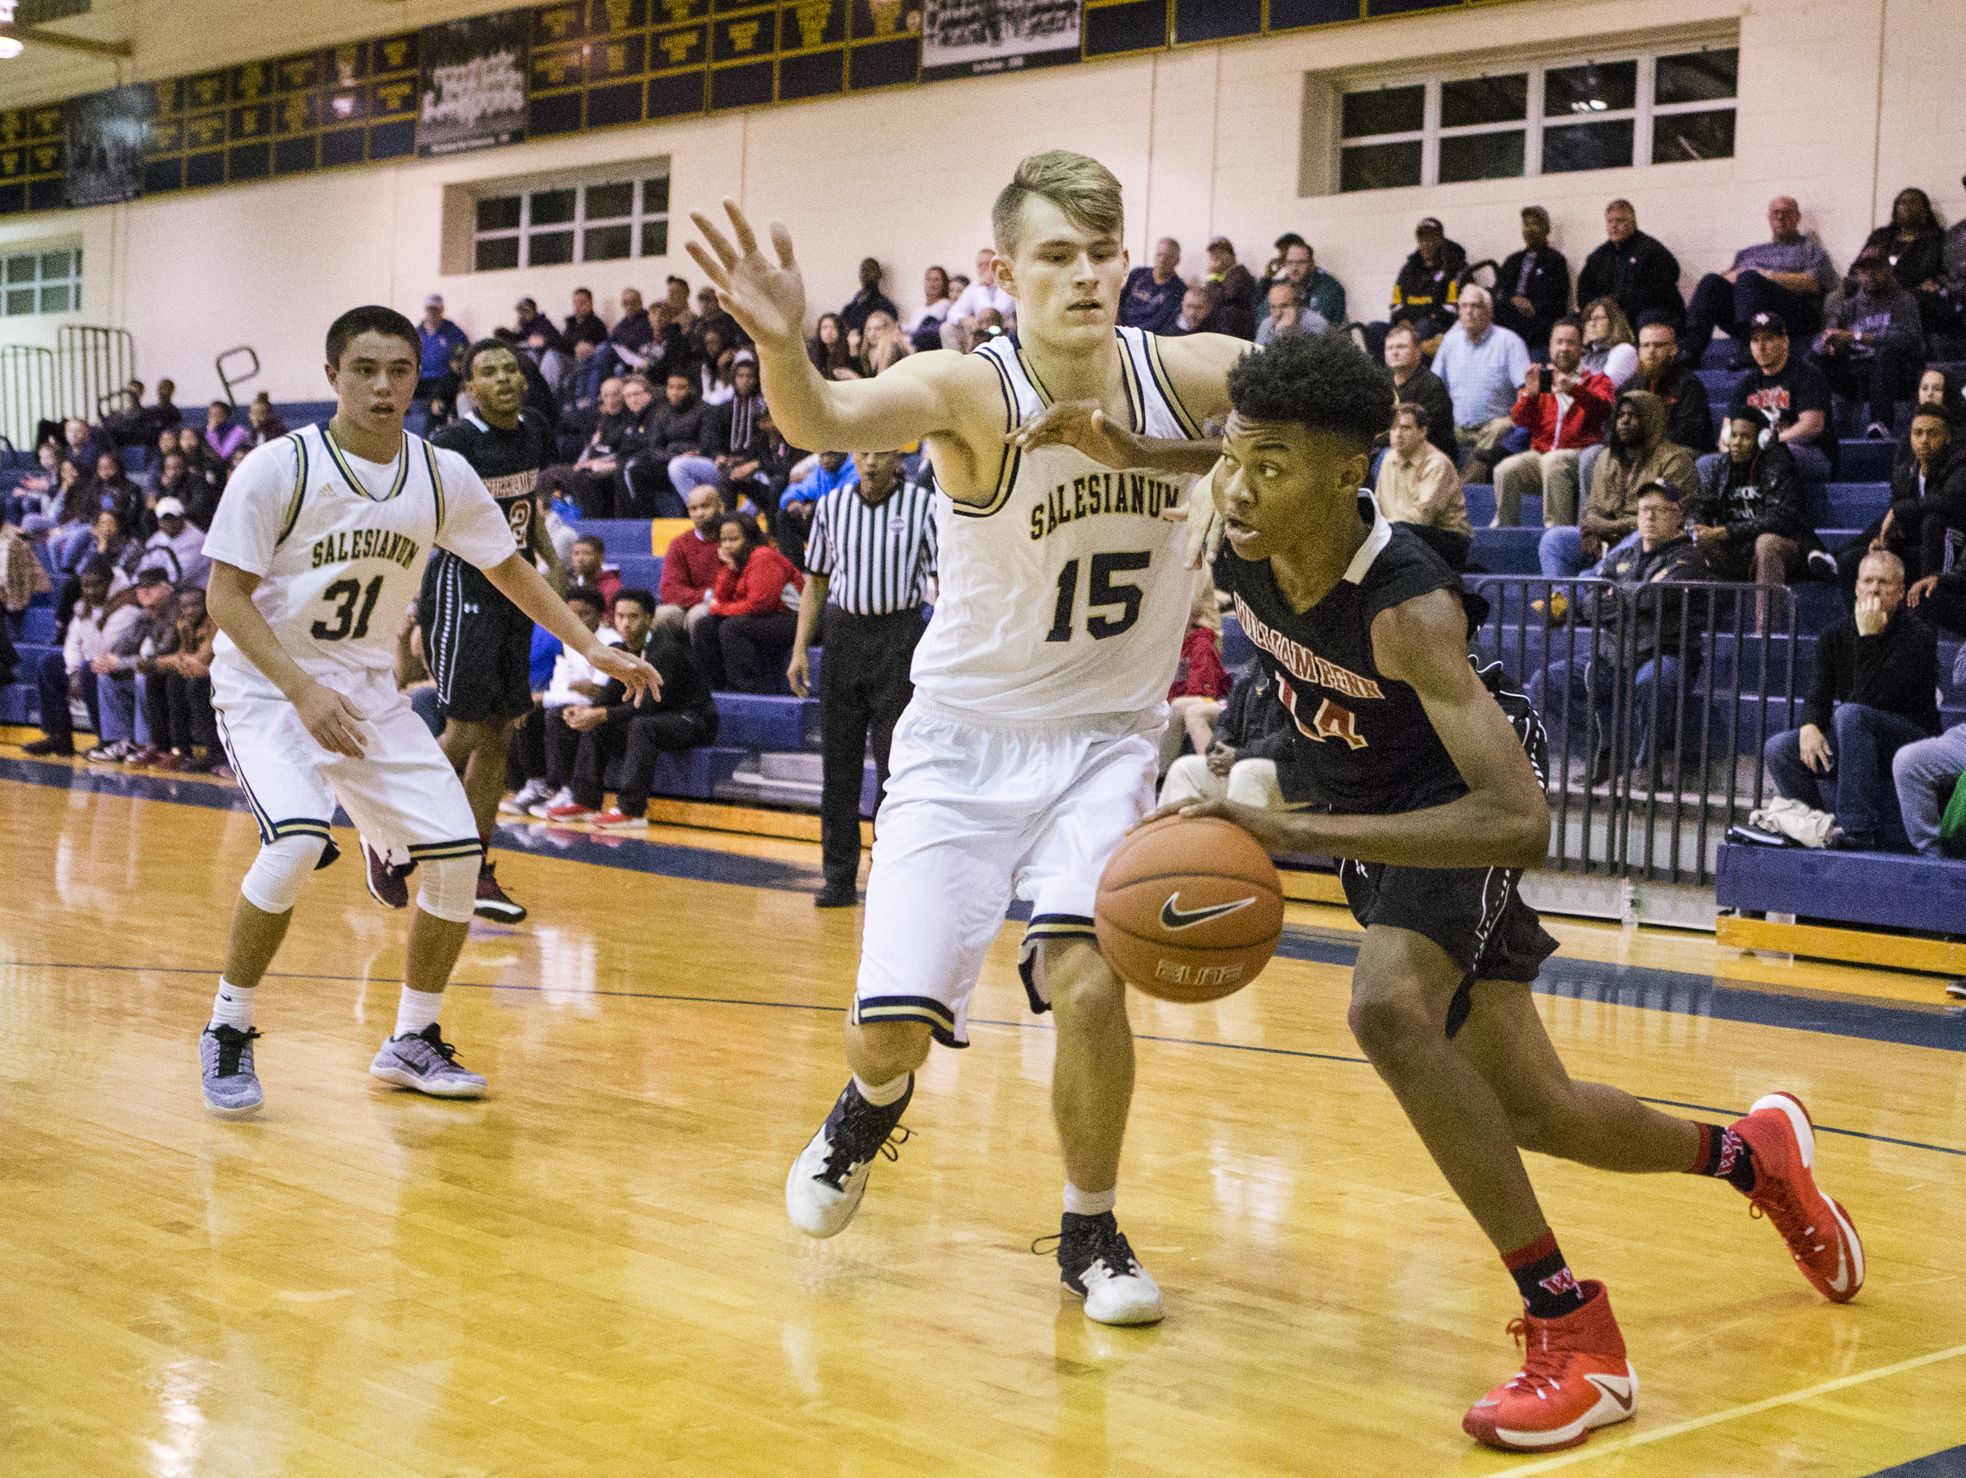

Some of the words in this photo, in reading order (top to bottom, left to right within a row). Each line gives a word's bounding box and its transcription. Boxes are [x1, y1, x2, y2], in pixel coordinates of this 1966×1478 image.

[1031, 473, 1179, 540] SALESIANUM
[312, 529, 419, 570] SALESIANUM
[311, 575, 384, 641] 31
[1046, 551, 1151, 642] 15
[1314, 656, 1386, 699] PENN
